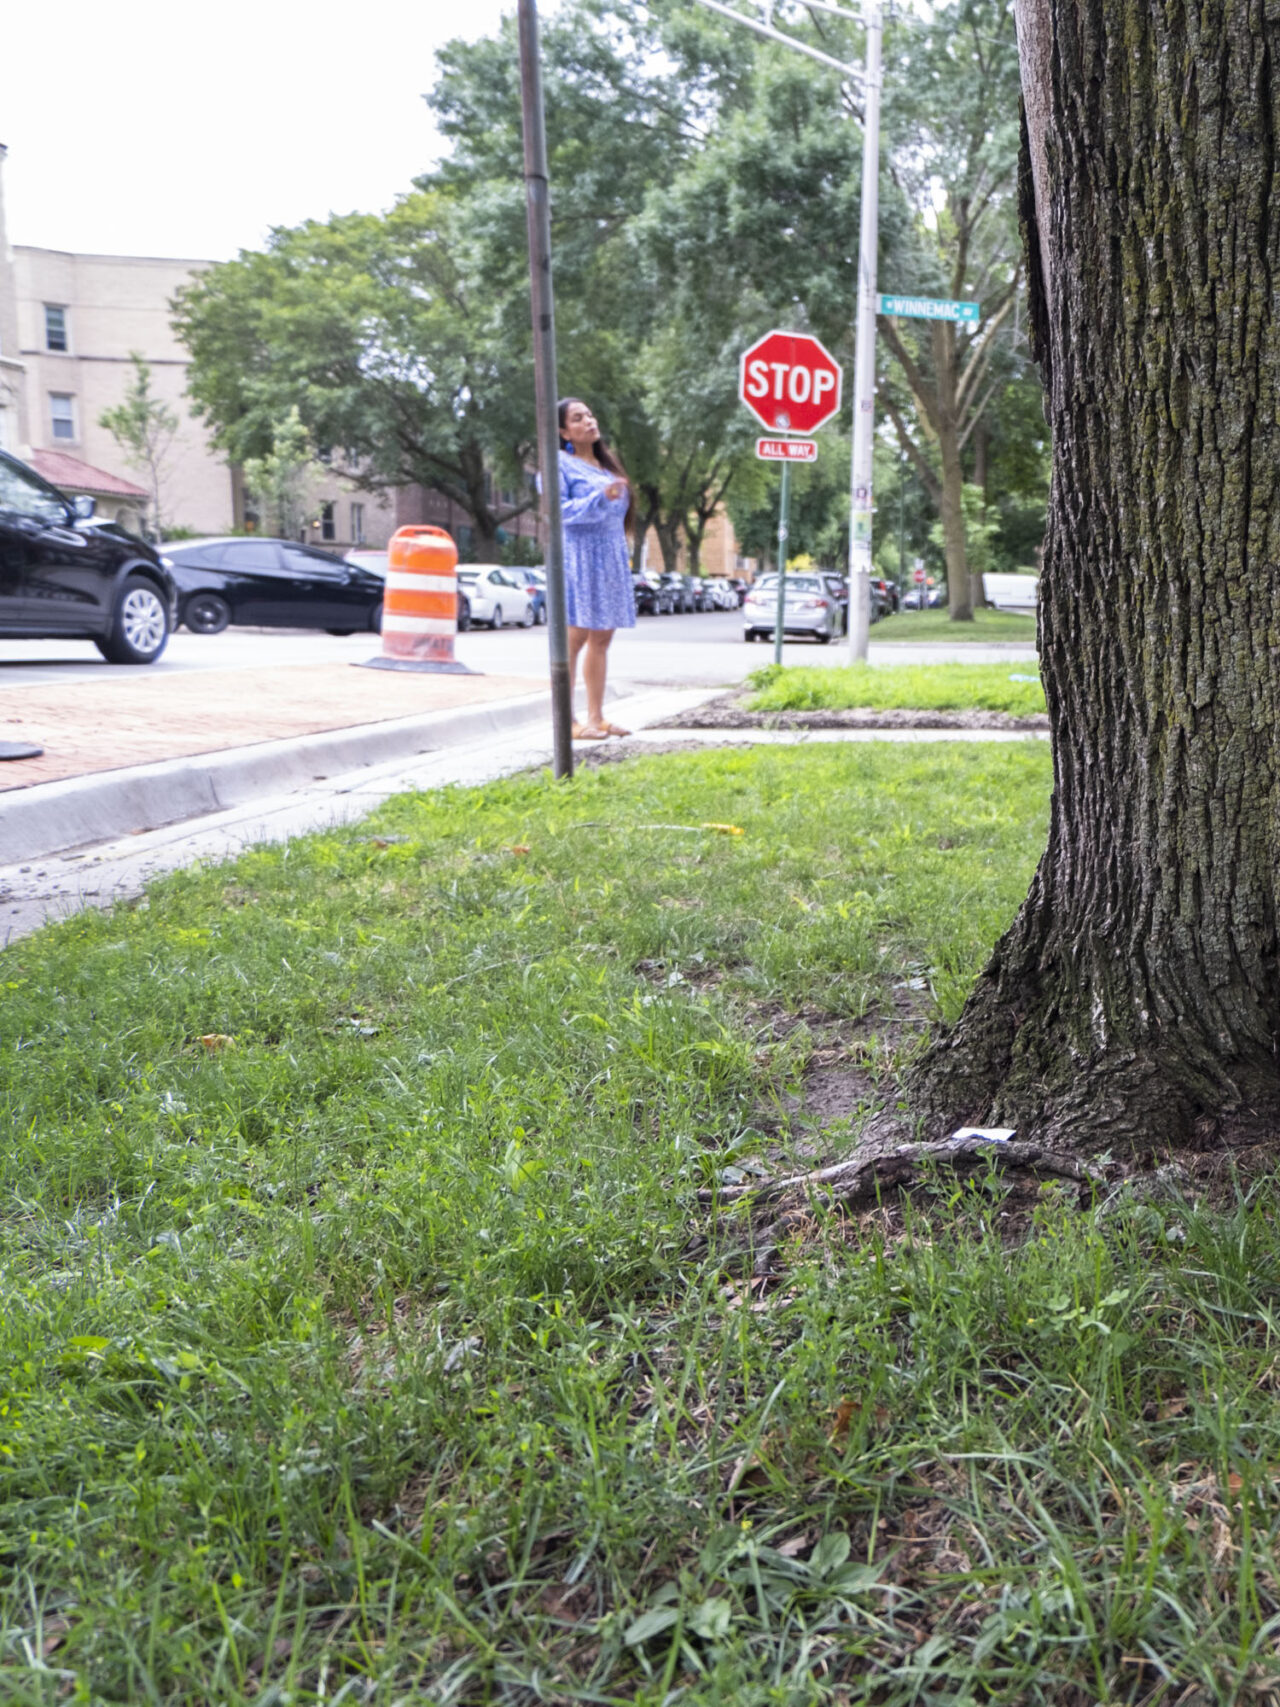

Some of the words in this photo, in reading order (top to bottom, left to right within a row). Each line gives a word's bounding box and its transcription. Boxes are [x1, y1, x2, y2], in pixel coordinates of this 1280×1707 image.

[894, 299, 960, 318] WINNEMAC
[747, 360, 835, 405] STOP
[762, 442, 785, 456] ALL
[788, 444, 811, 457] WAY
